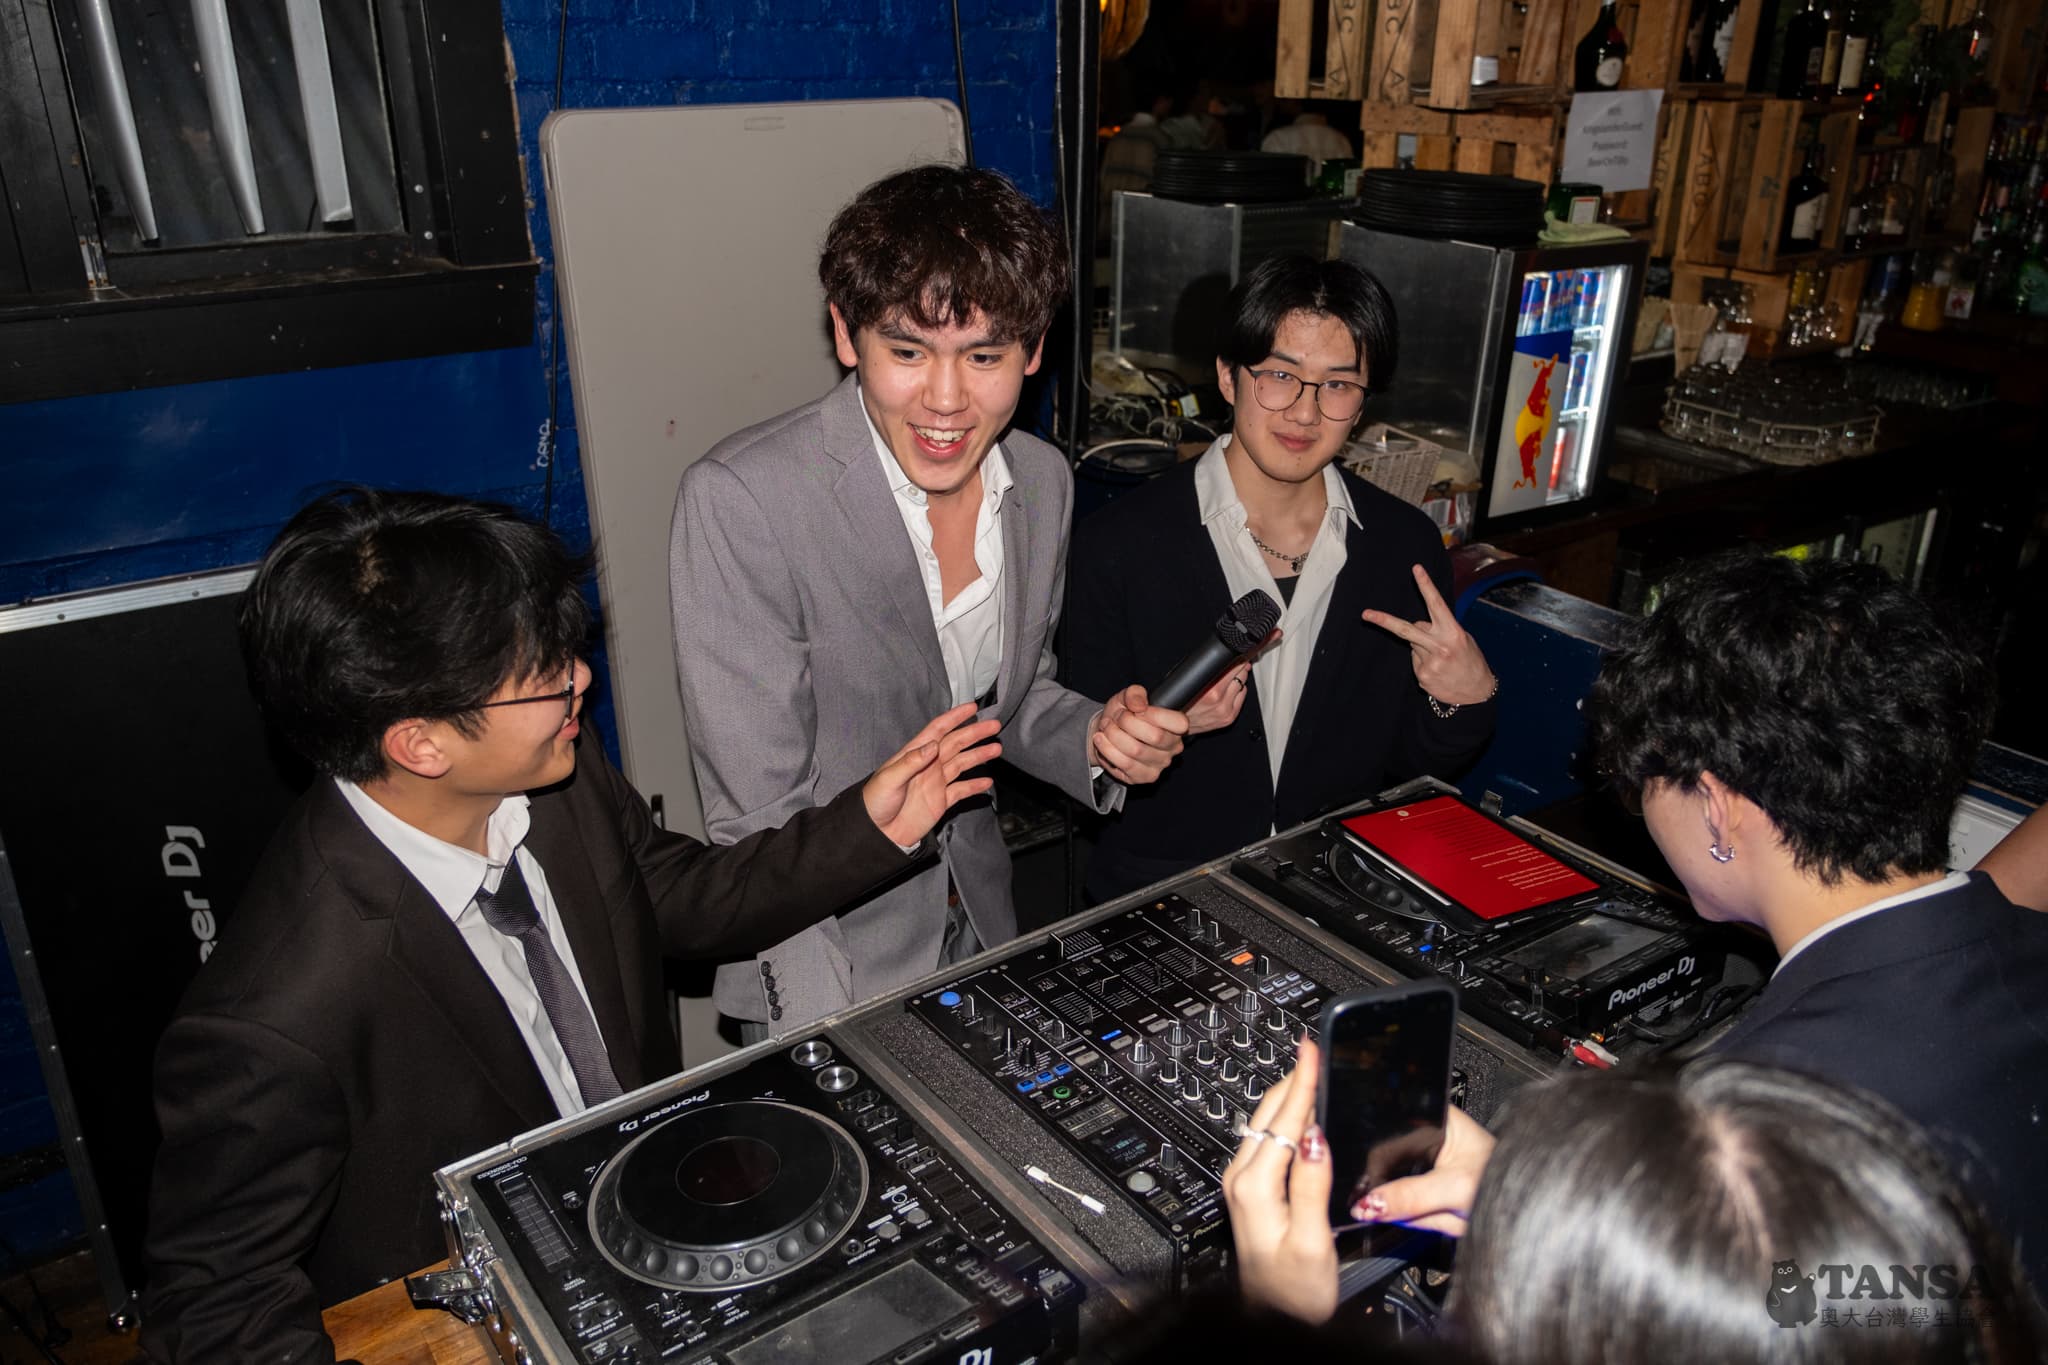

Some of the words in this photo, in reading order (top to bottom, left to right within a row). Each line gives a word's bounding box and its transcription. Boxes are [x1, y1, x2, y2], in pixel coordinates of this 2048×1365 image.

[1607, 967, 1675, 1011] Pioneer
[1676, 956, 1696, 976] DJ
[643, 1089, 711, 1122] Pioneer
[618, 1118, 640, 1133] DJ
